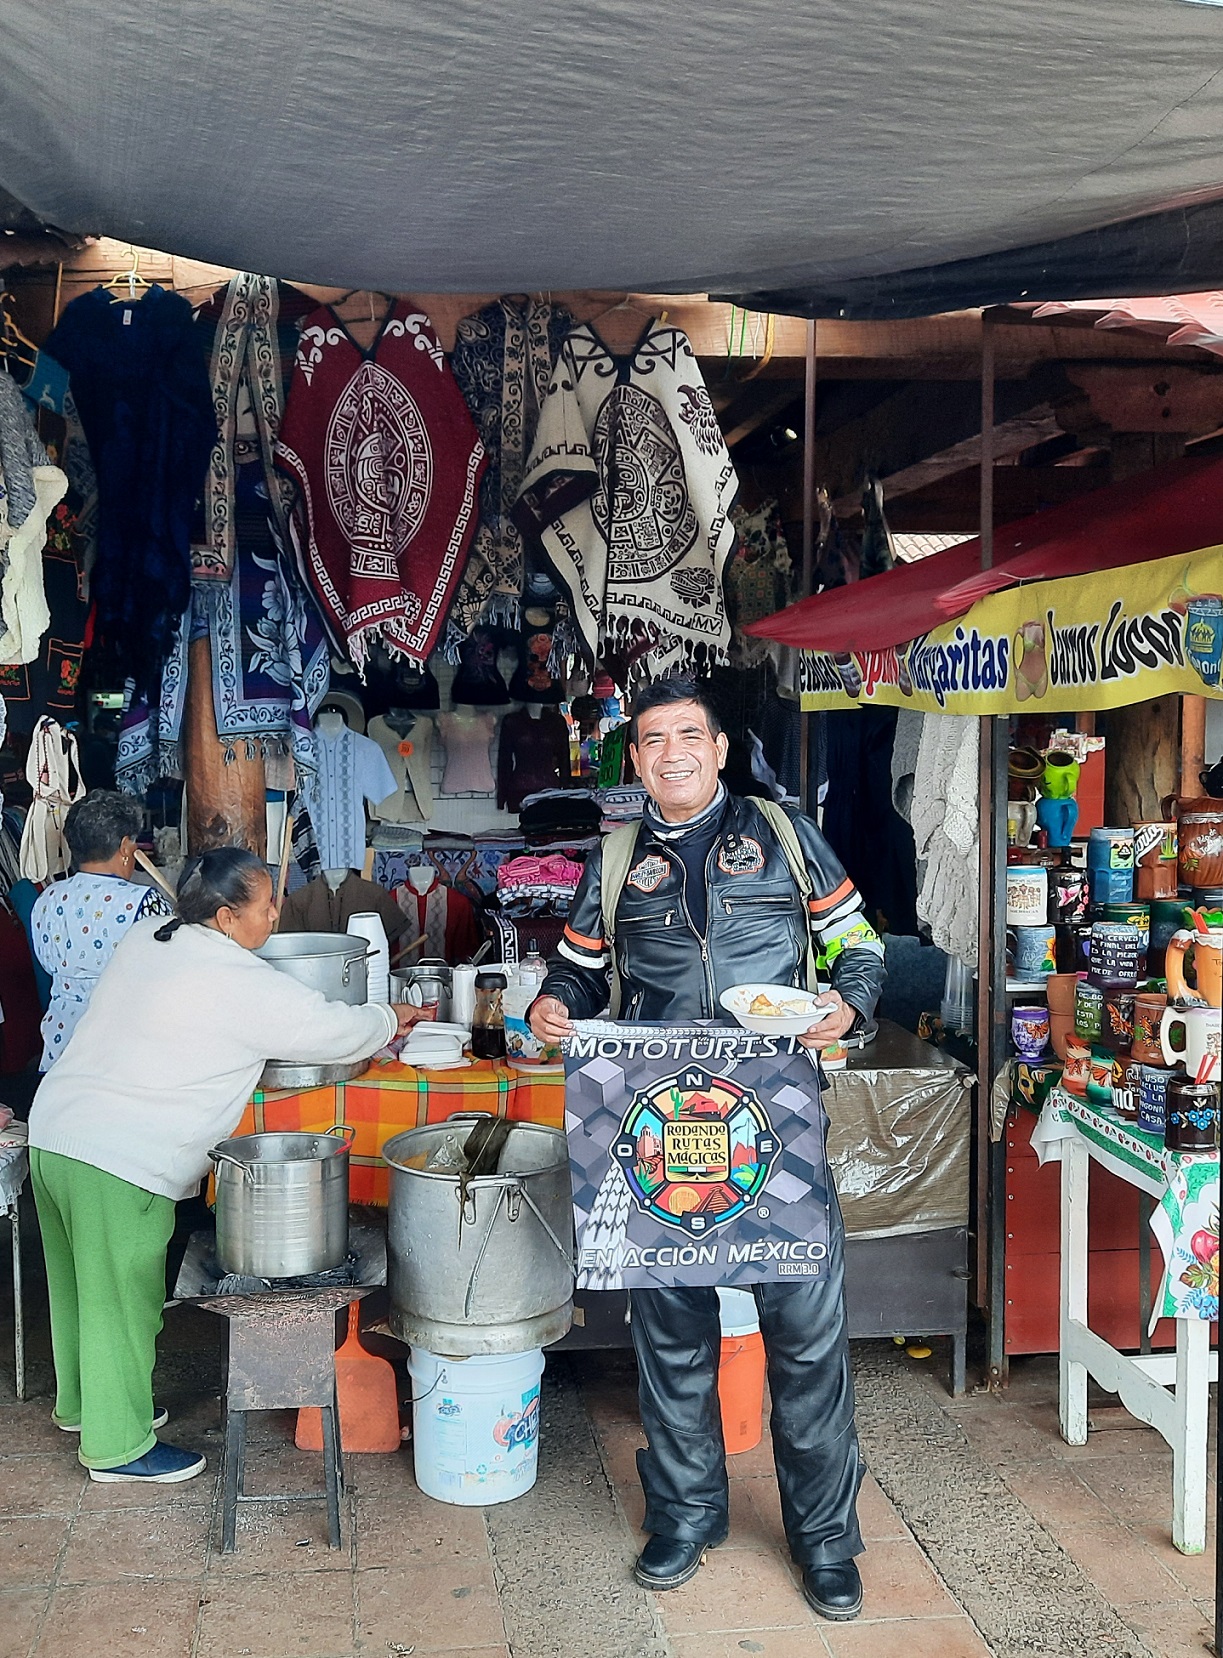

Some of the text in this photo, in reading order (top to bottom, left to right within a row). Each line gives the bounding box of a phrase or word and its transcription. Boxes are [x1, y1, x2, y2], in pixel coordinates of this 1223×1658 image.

[695, 615, 720, 632] MV
[1047, 601, 1184, 685] Jarros Locos
[1106, 958, 1116, 967] LA
[686, 1073, 703, 1087] N
[1145, 1074, 1165, 1084] USO
[1152, 1093, 1164, 1103] LA
[760, 1139, 773, 1153] E
[691, 1217, 706, 1230] S
[582, 1238, 827, 1268] EN ACCIÓN MÉXICO
[778, 1264, 819, 1275] RRM 3.0
